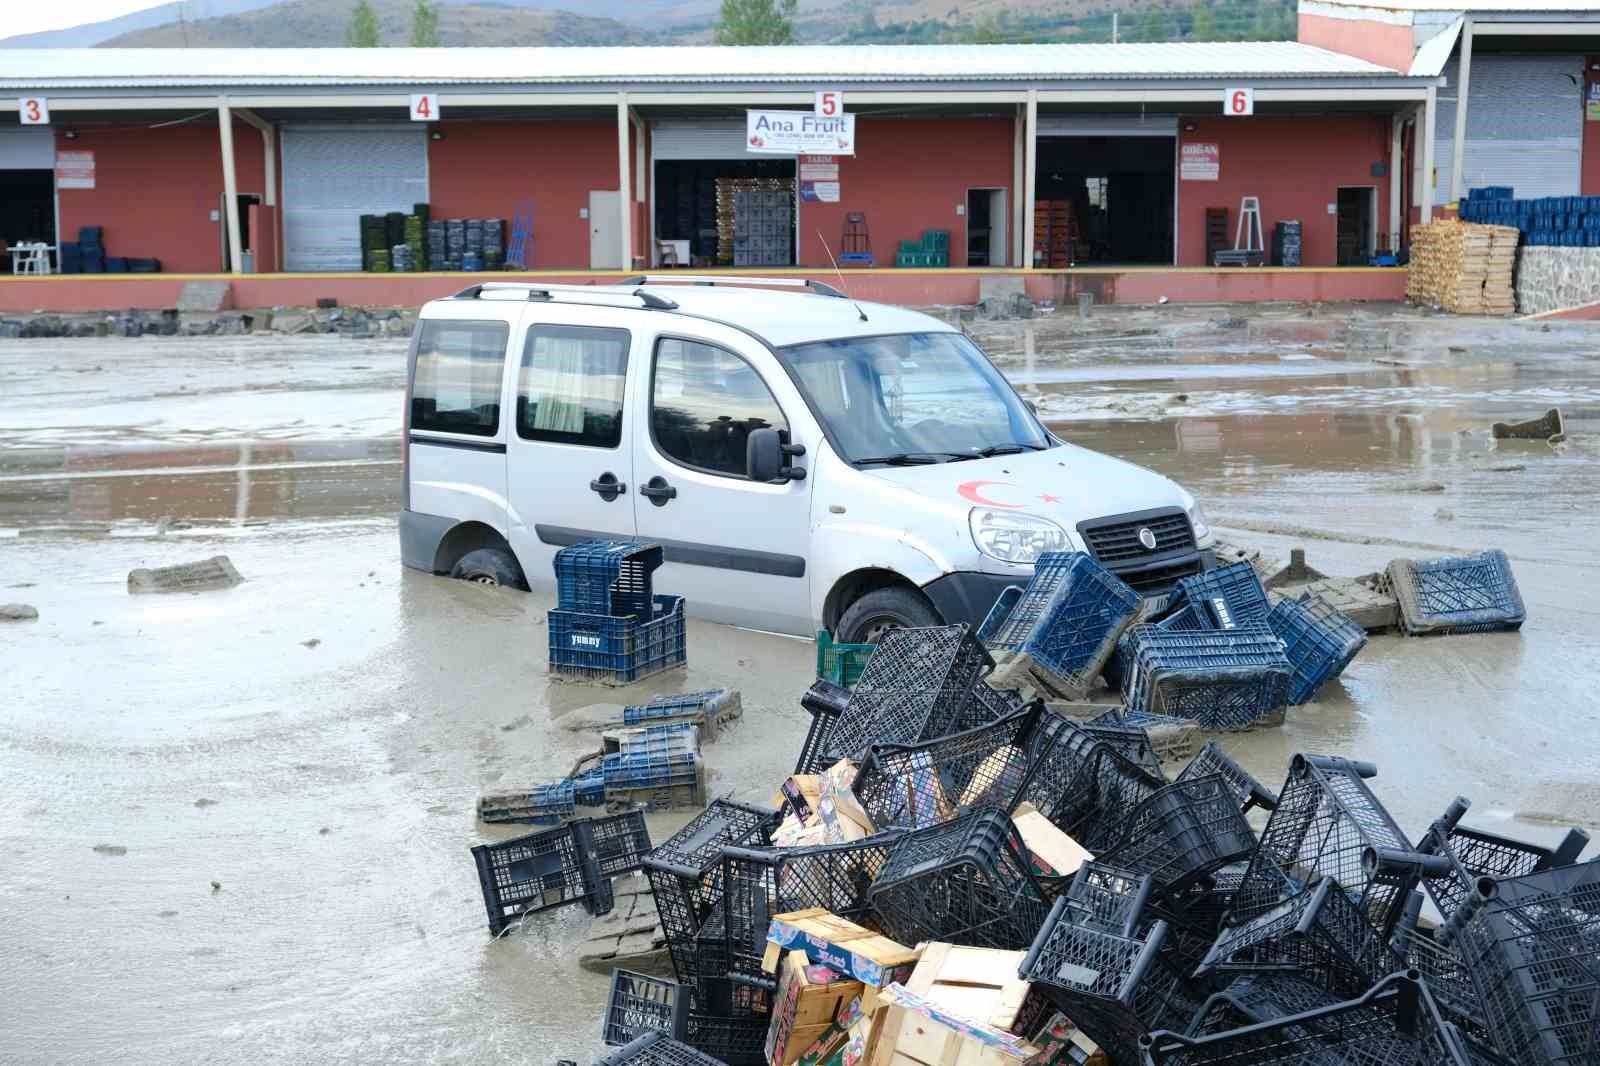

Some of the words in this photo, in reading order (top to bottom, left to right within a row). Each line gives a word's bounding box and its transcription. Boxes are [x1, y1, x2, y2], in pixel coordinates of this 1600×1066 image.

[26, 100, 41, 121] 3
[415, 97, 431, 118] 4
[822, 93, 836, 116] 5
[1232, 91, 1247, 113] 6
[755, 115, 794, 132] Ana
[802, 116, 847, 133] Fruit
[571, 634, 601, 648] yummy
